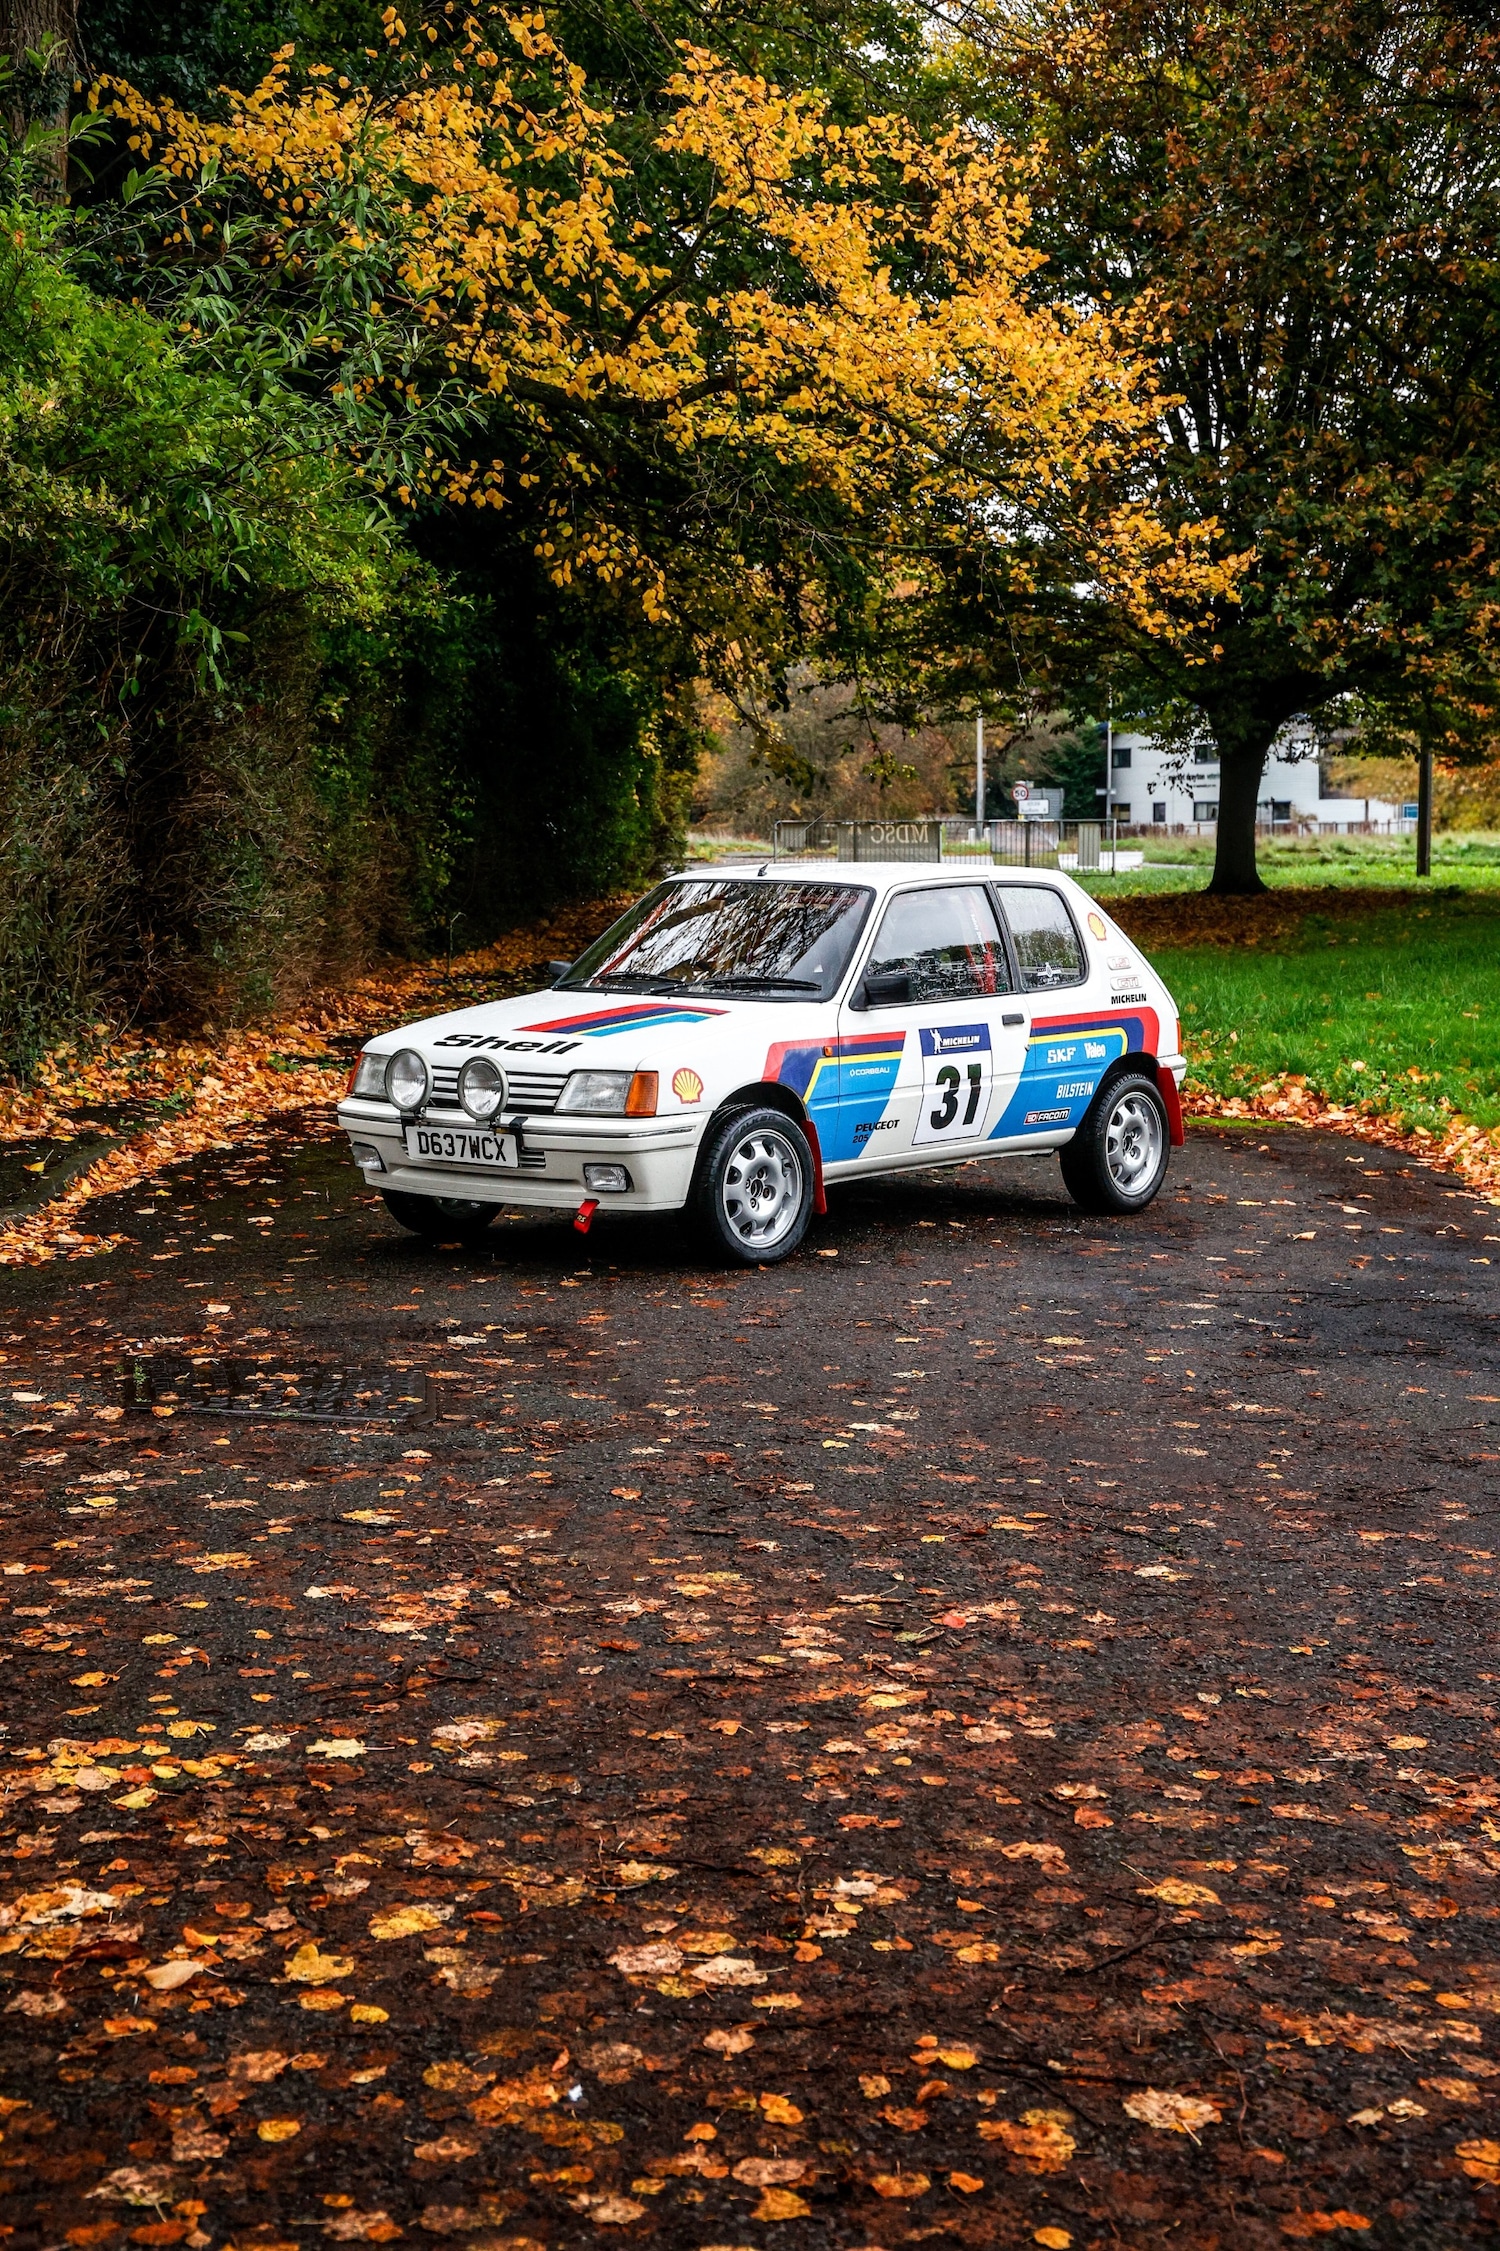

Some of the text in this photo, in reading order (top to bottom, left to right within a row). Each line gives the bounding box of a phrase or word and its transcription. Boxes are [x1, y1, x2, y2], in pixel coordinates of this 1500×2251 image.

[1014, 790, 1026, 798] 50
[1110, 993, 1147, 1004] MICHELIN
[433, 1034, 584, 1055] Shell
[941, 1035, 980, 1046] MICHELIN
[1047, 1042, 1107, 1064] SKF Valeo
[855, 1066, 890, 1076] CORBEAU
[1056, 1081, 1094, 1099] BILSTEIN
[930, 1063, 981, 1130] 31
[1038, 1110, 1069, 1121] FACOM
[855, 1119, 900, 1133] PEUGEOT
[852, 1134, 869, 1144] 205
[417, 1131, 507, 1162] D637WCX
